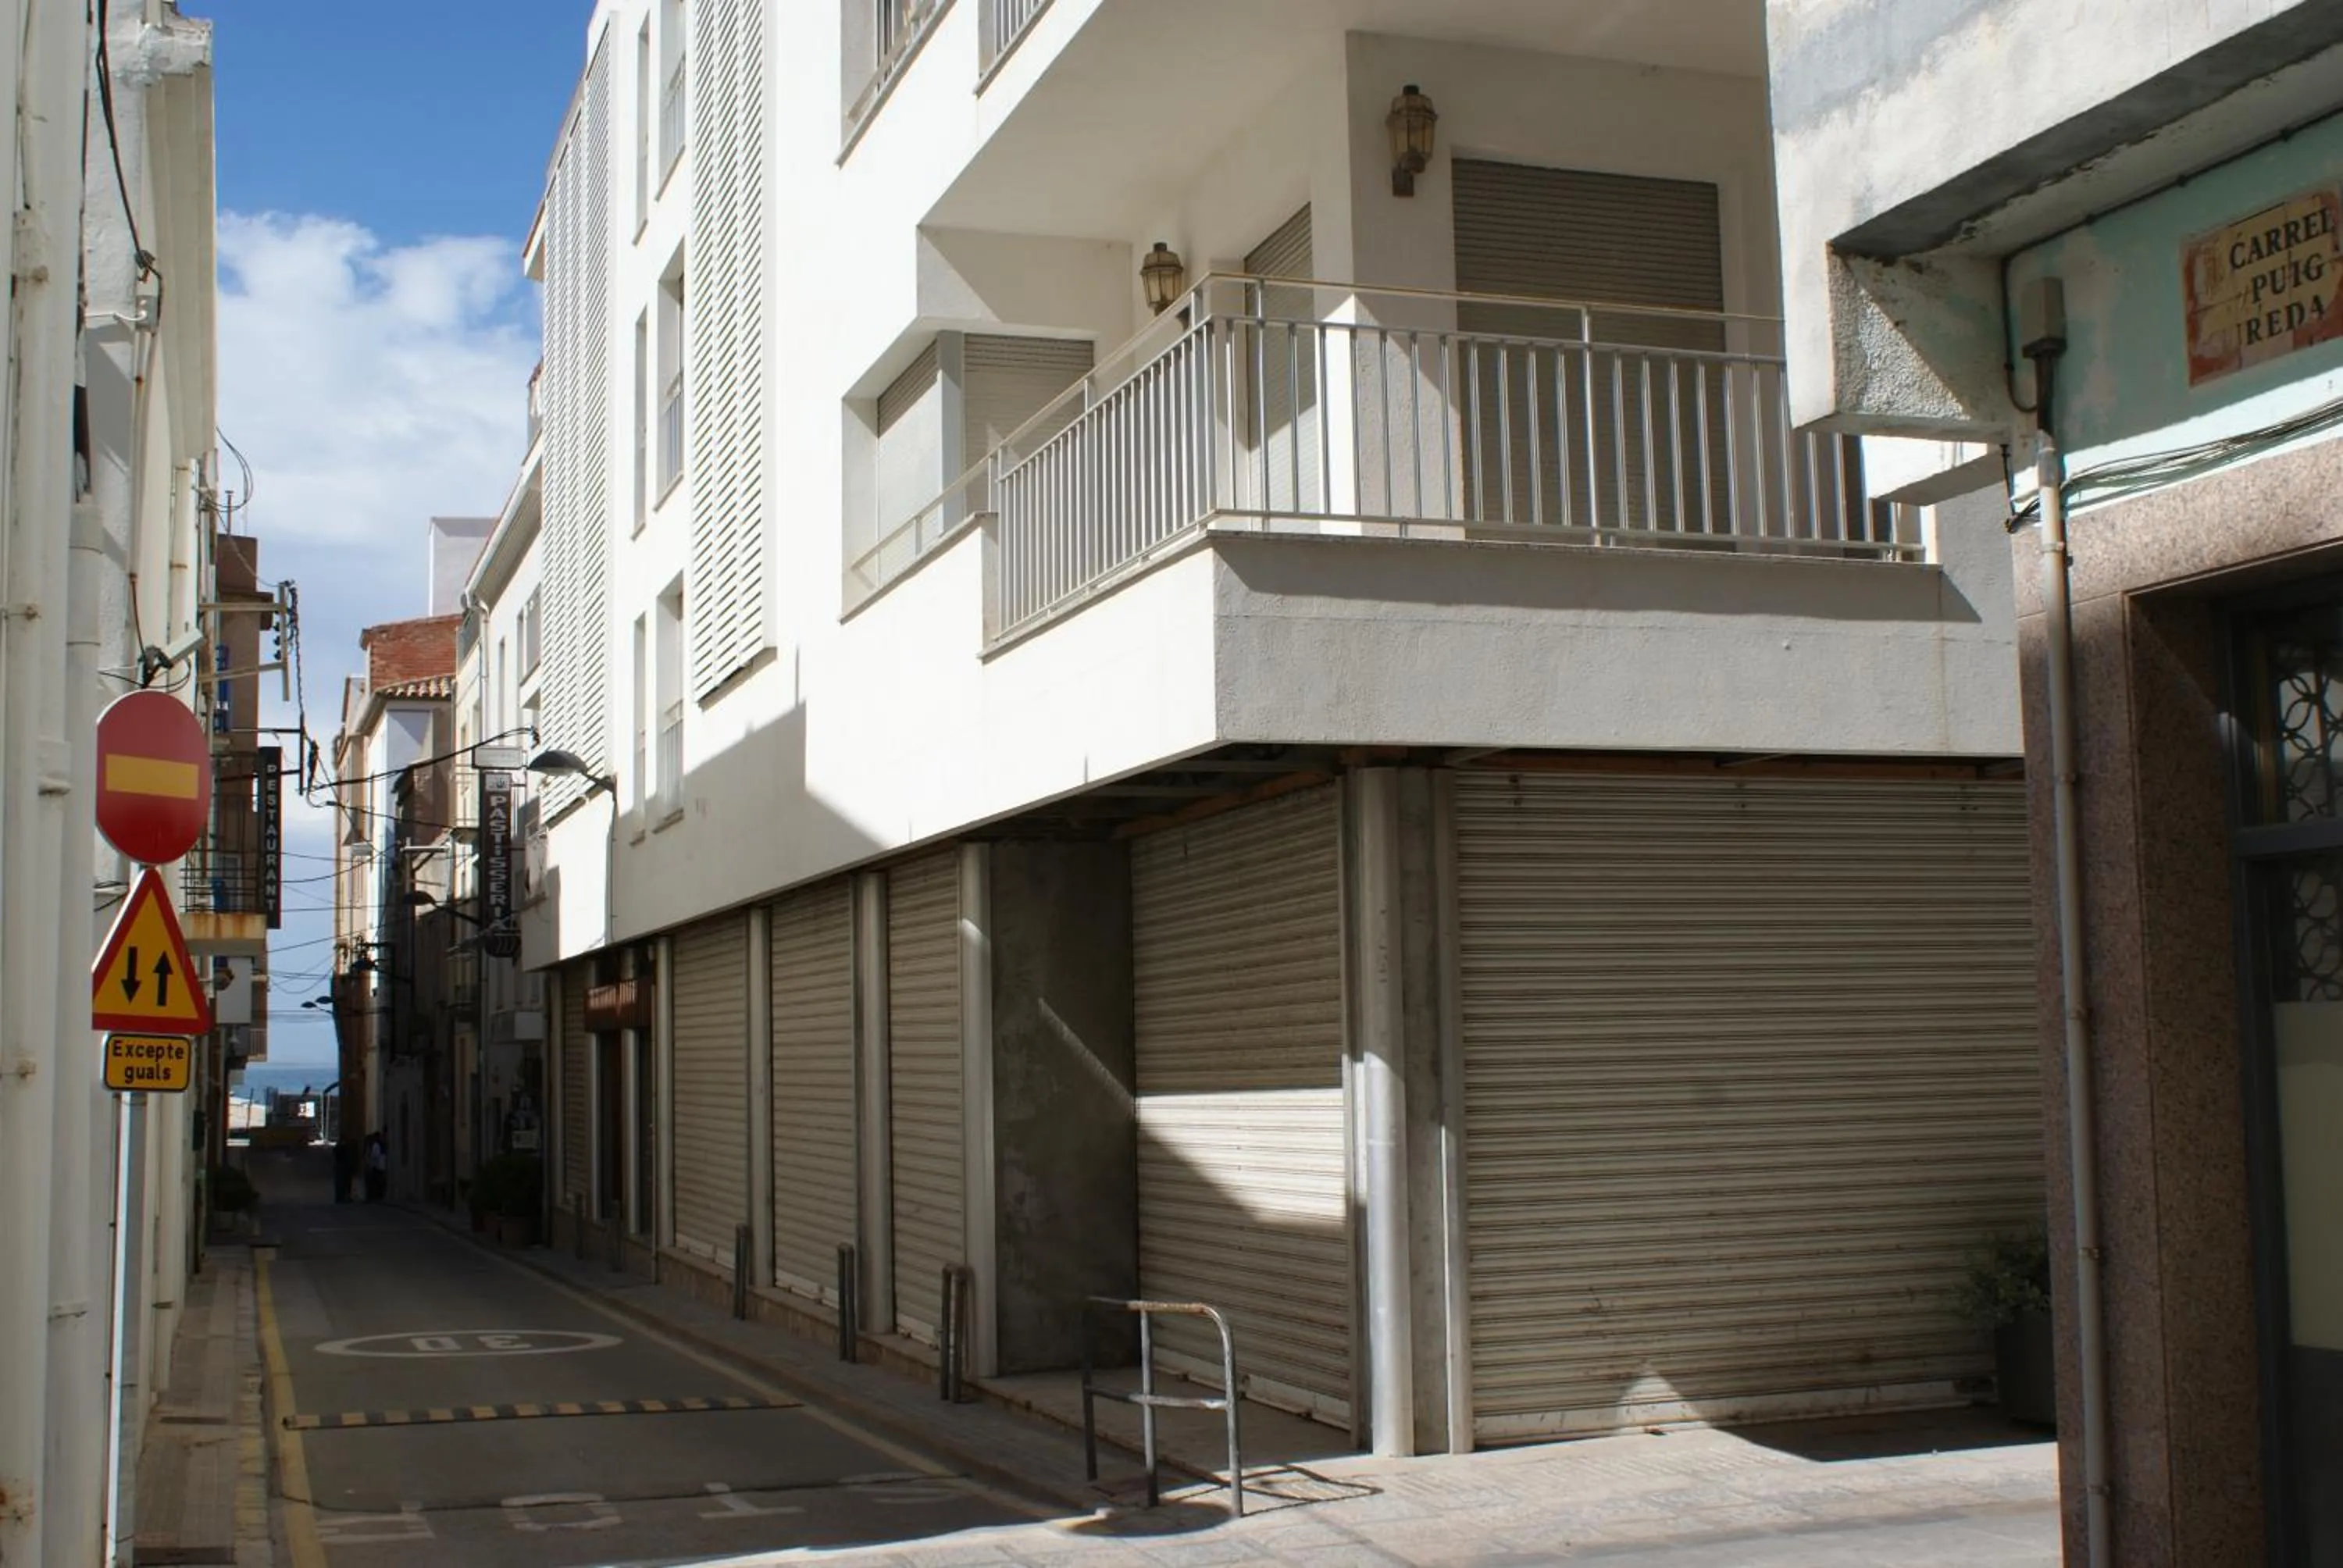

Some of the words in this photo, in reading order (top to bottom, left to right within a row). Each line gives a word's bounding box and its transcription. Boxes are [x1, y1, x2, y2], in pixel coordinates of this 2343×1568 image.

[2252, 252, 2324, 304] PUIG
[2246, 294, 2325, 346] REDA
[112, 1040, 184, 1062] Excepte
[124, 1063, 172, 1084] guals
